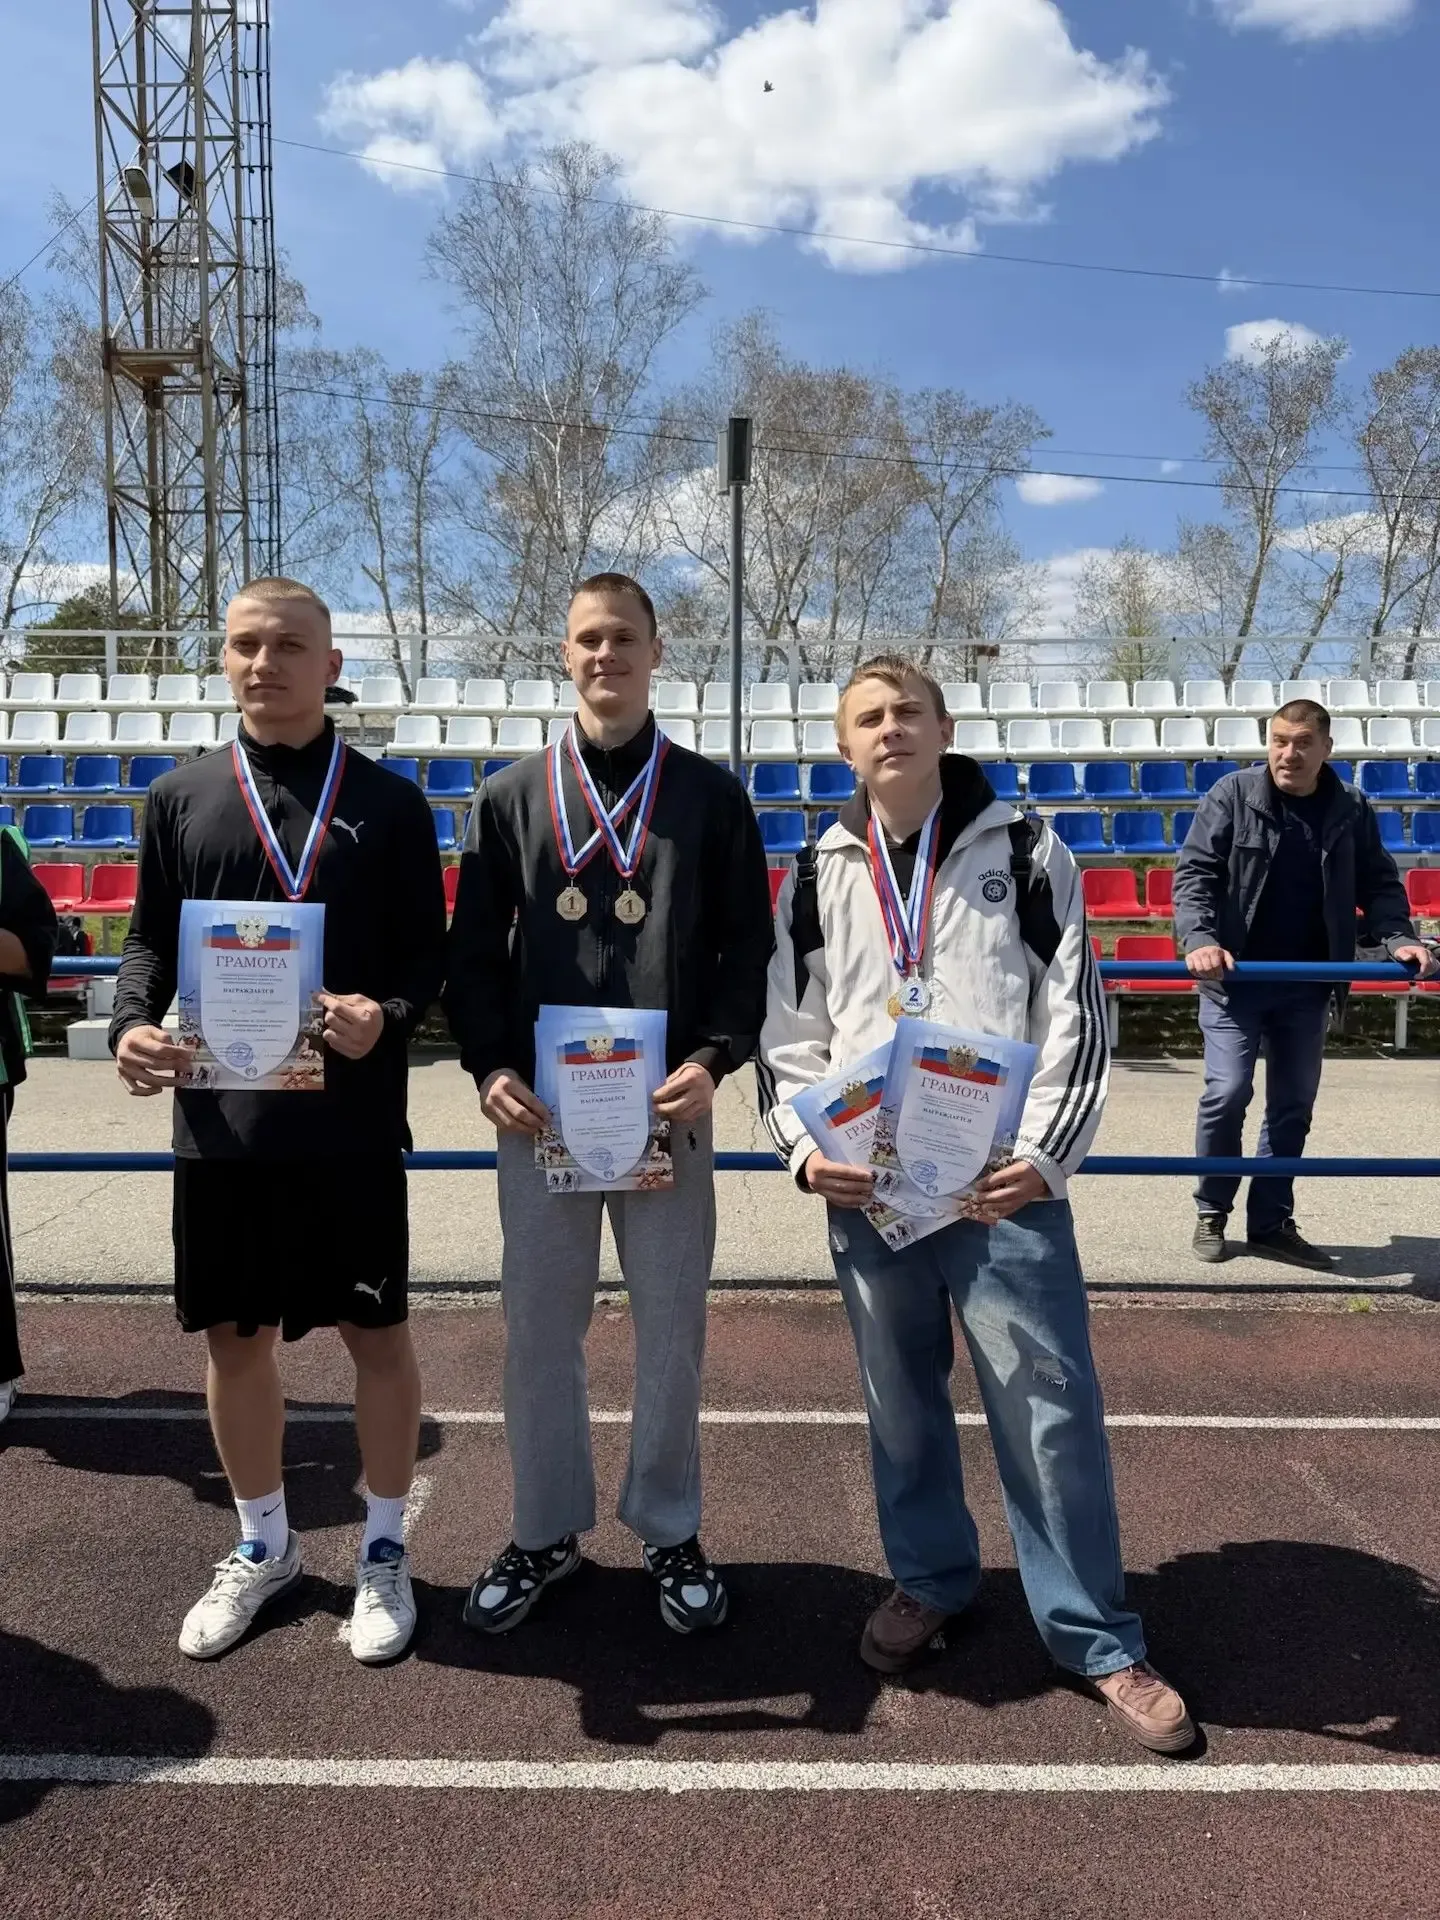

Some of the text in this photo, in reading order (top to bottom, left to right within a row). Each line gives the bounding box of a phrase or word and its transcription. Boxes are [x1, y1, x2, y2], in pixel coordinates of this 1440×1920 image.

[567, 896, 575, 909] 1
[626, 900, 633, 913] 1
[215, 955, 288, 969] ГРАМОТА
[909, 987, 919, 1001] 2
[571, 1067, 635, 1082] ГРАМОТА
[920, 1076, 990, 1103] ГРАМОТА
